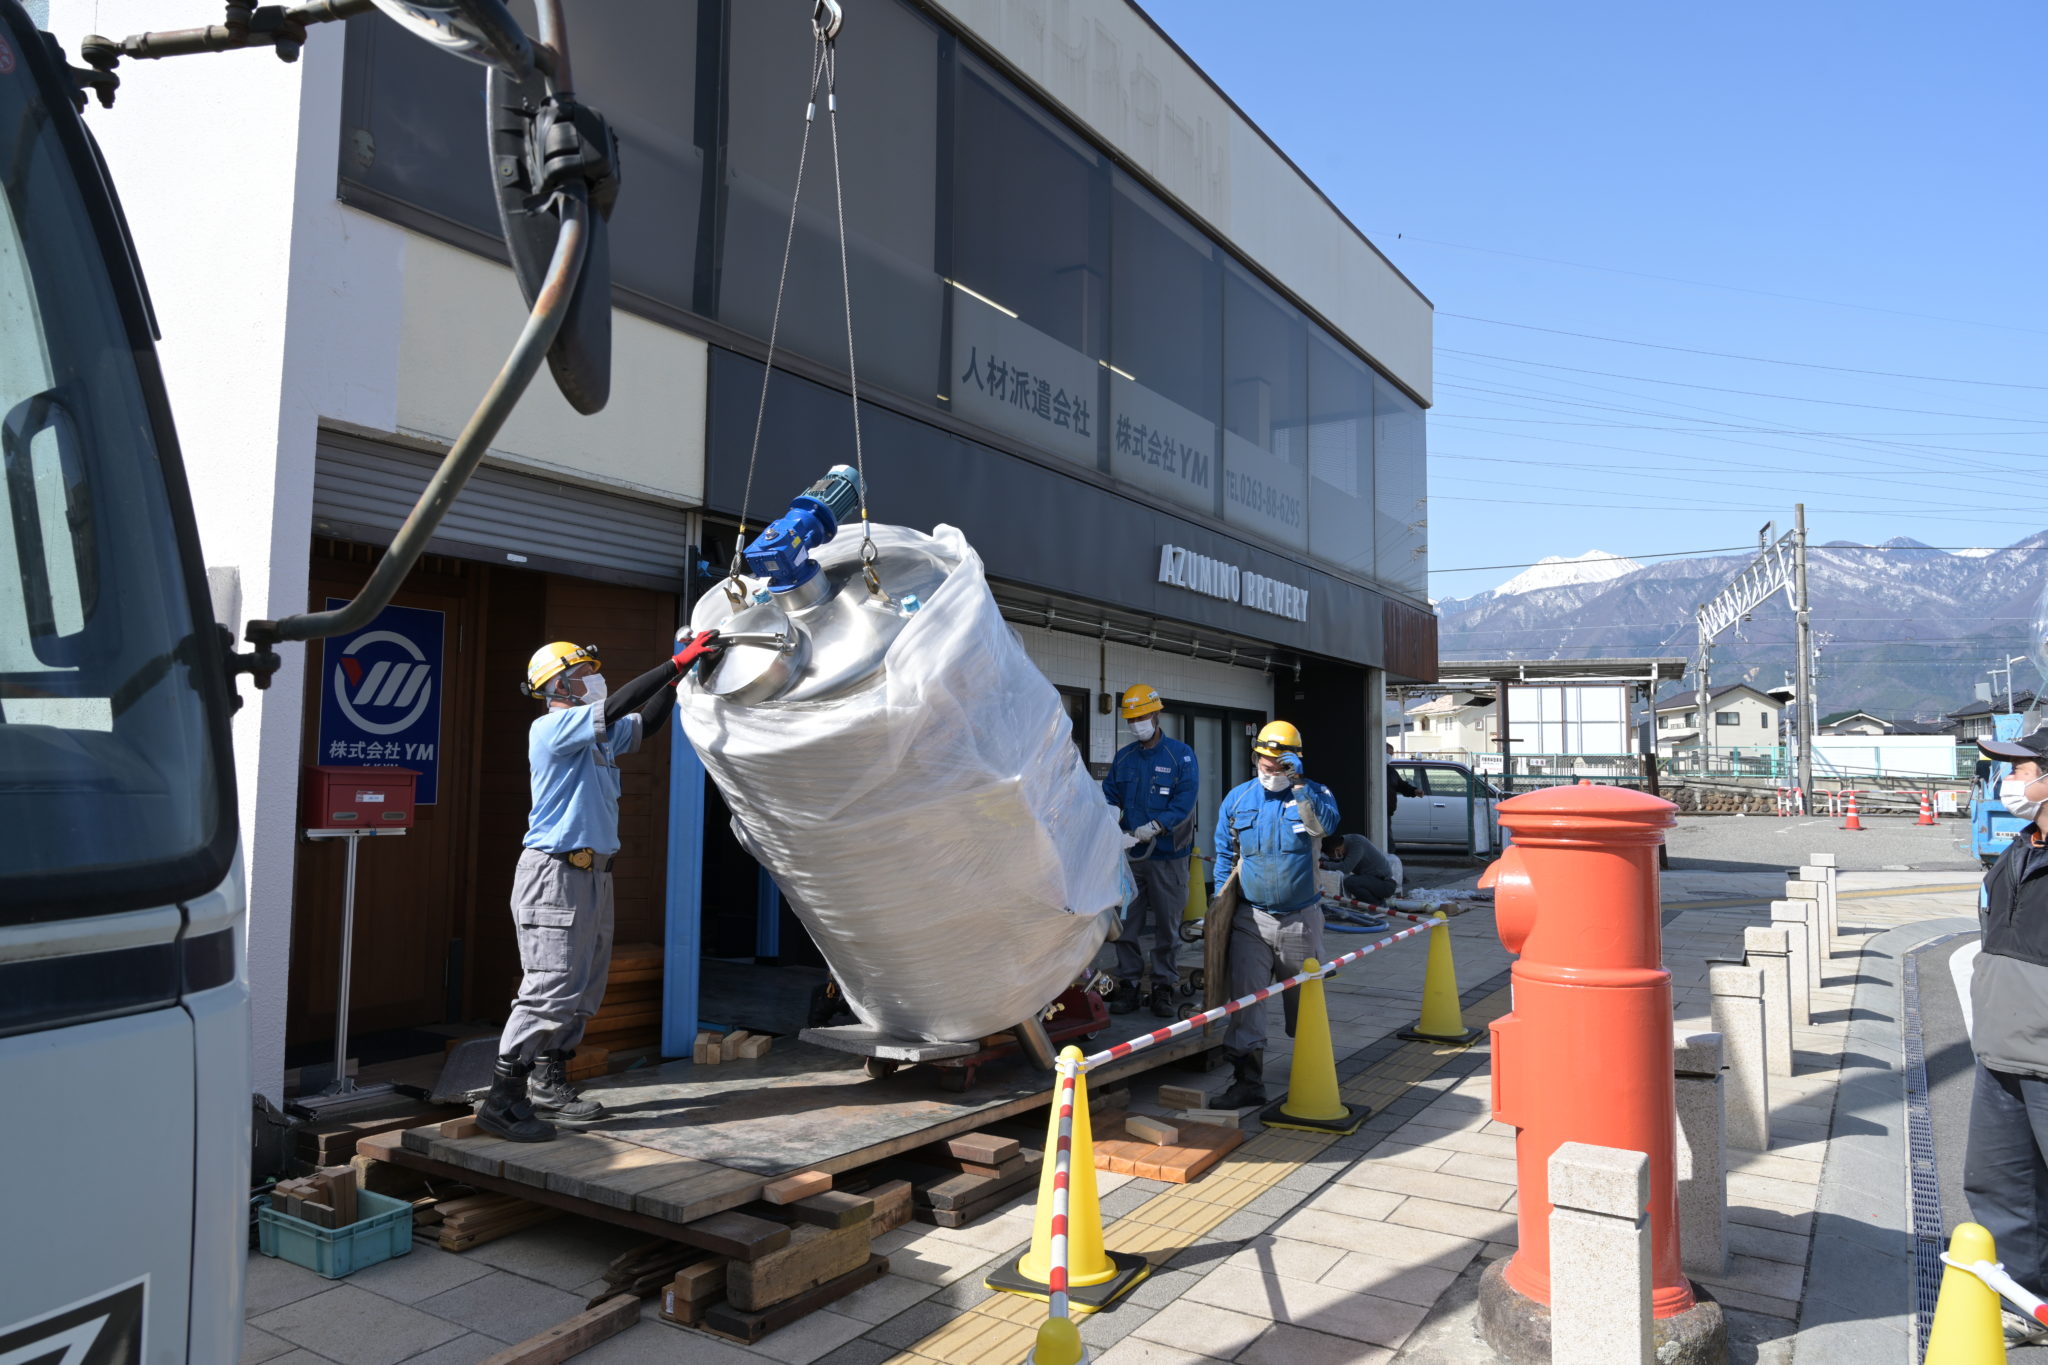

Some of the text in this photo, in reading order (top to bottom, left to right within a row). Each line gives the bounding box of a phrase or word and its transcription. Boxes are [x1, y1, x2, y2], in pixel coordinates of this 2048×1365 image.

[962, 347, 1090, 438] 人材派遣会社
[1159, 543, 1309, 622] AZUMINO BREWERY
